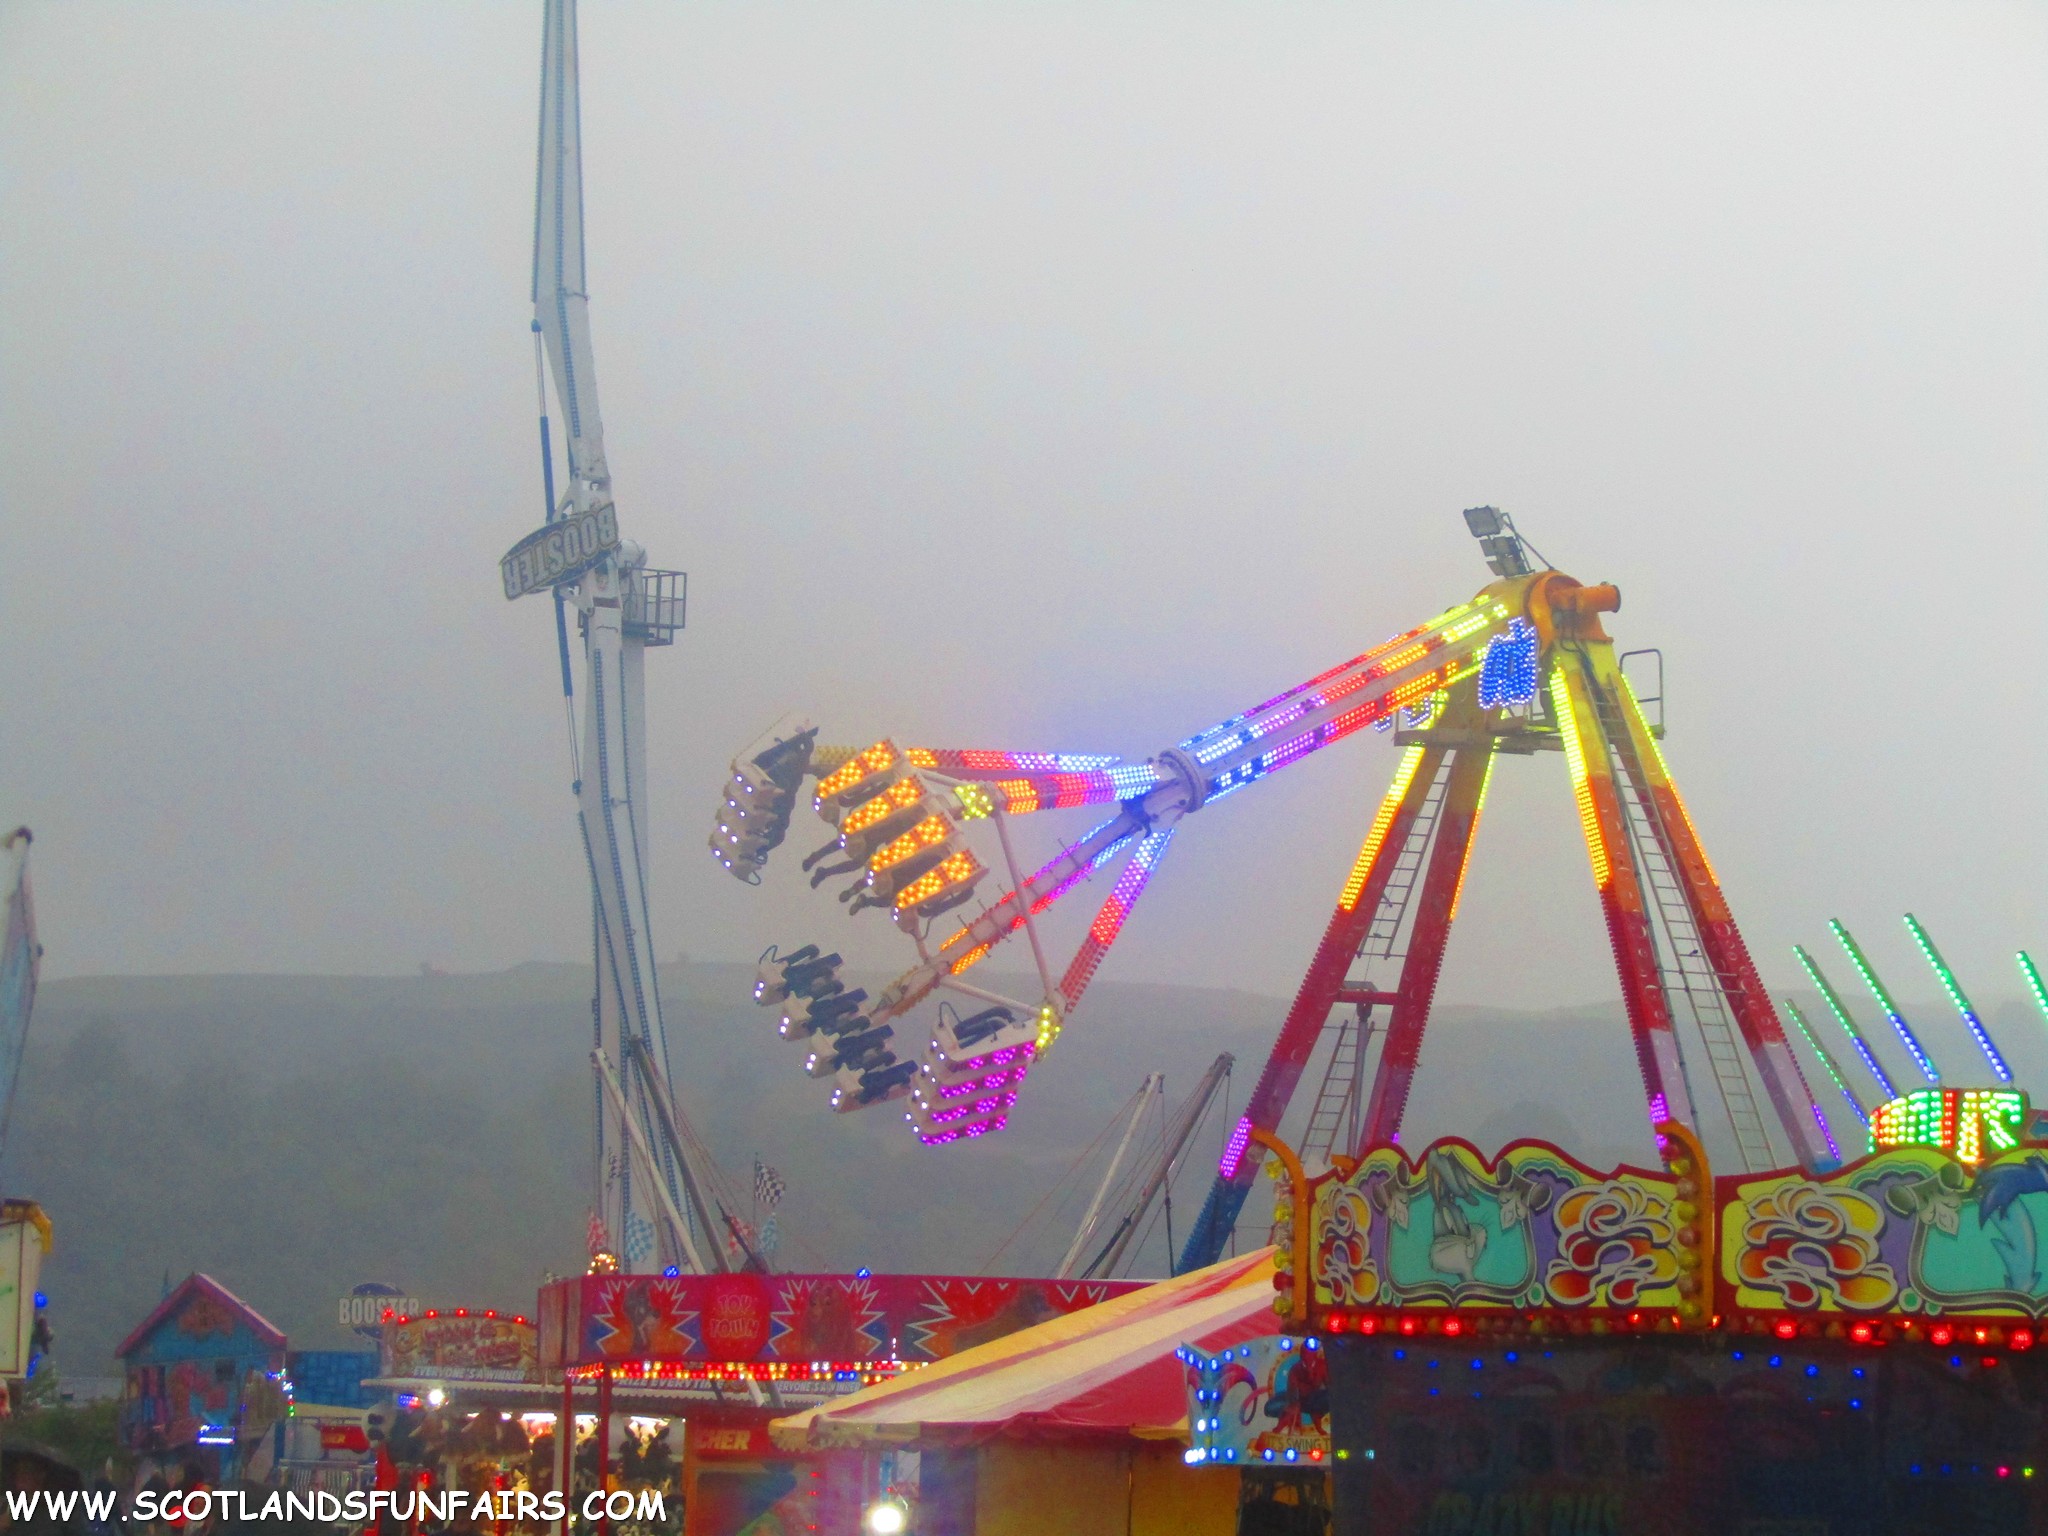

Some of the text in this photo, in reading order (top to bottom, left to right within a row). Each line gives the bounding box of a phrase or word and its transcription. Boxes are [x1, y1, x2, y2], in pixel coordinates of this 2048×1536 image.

[503, 503, 617, 601] BOOSTER
[338, 1297, 420, 1324] BOOSTER
[718, 1294, 752, 1314] TOY
[710, 1318, 759, 1338] TOWN
